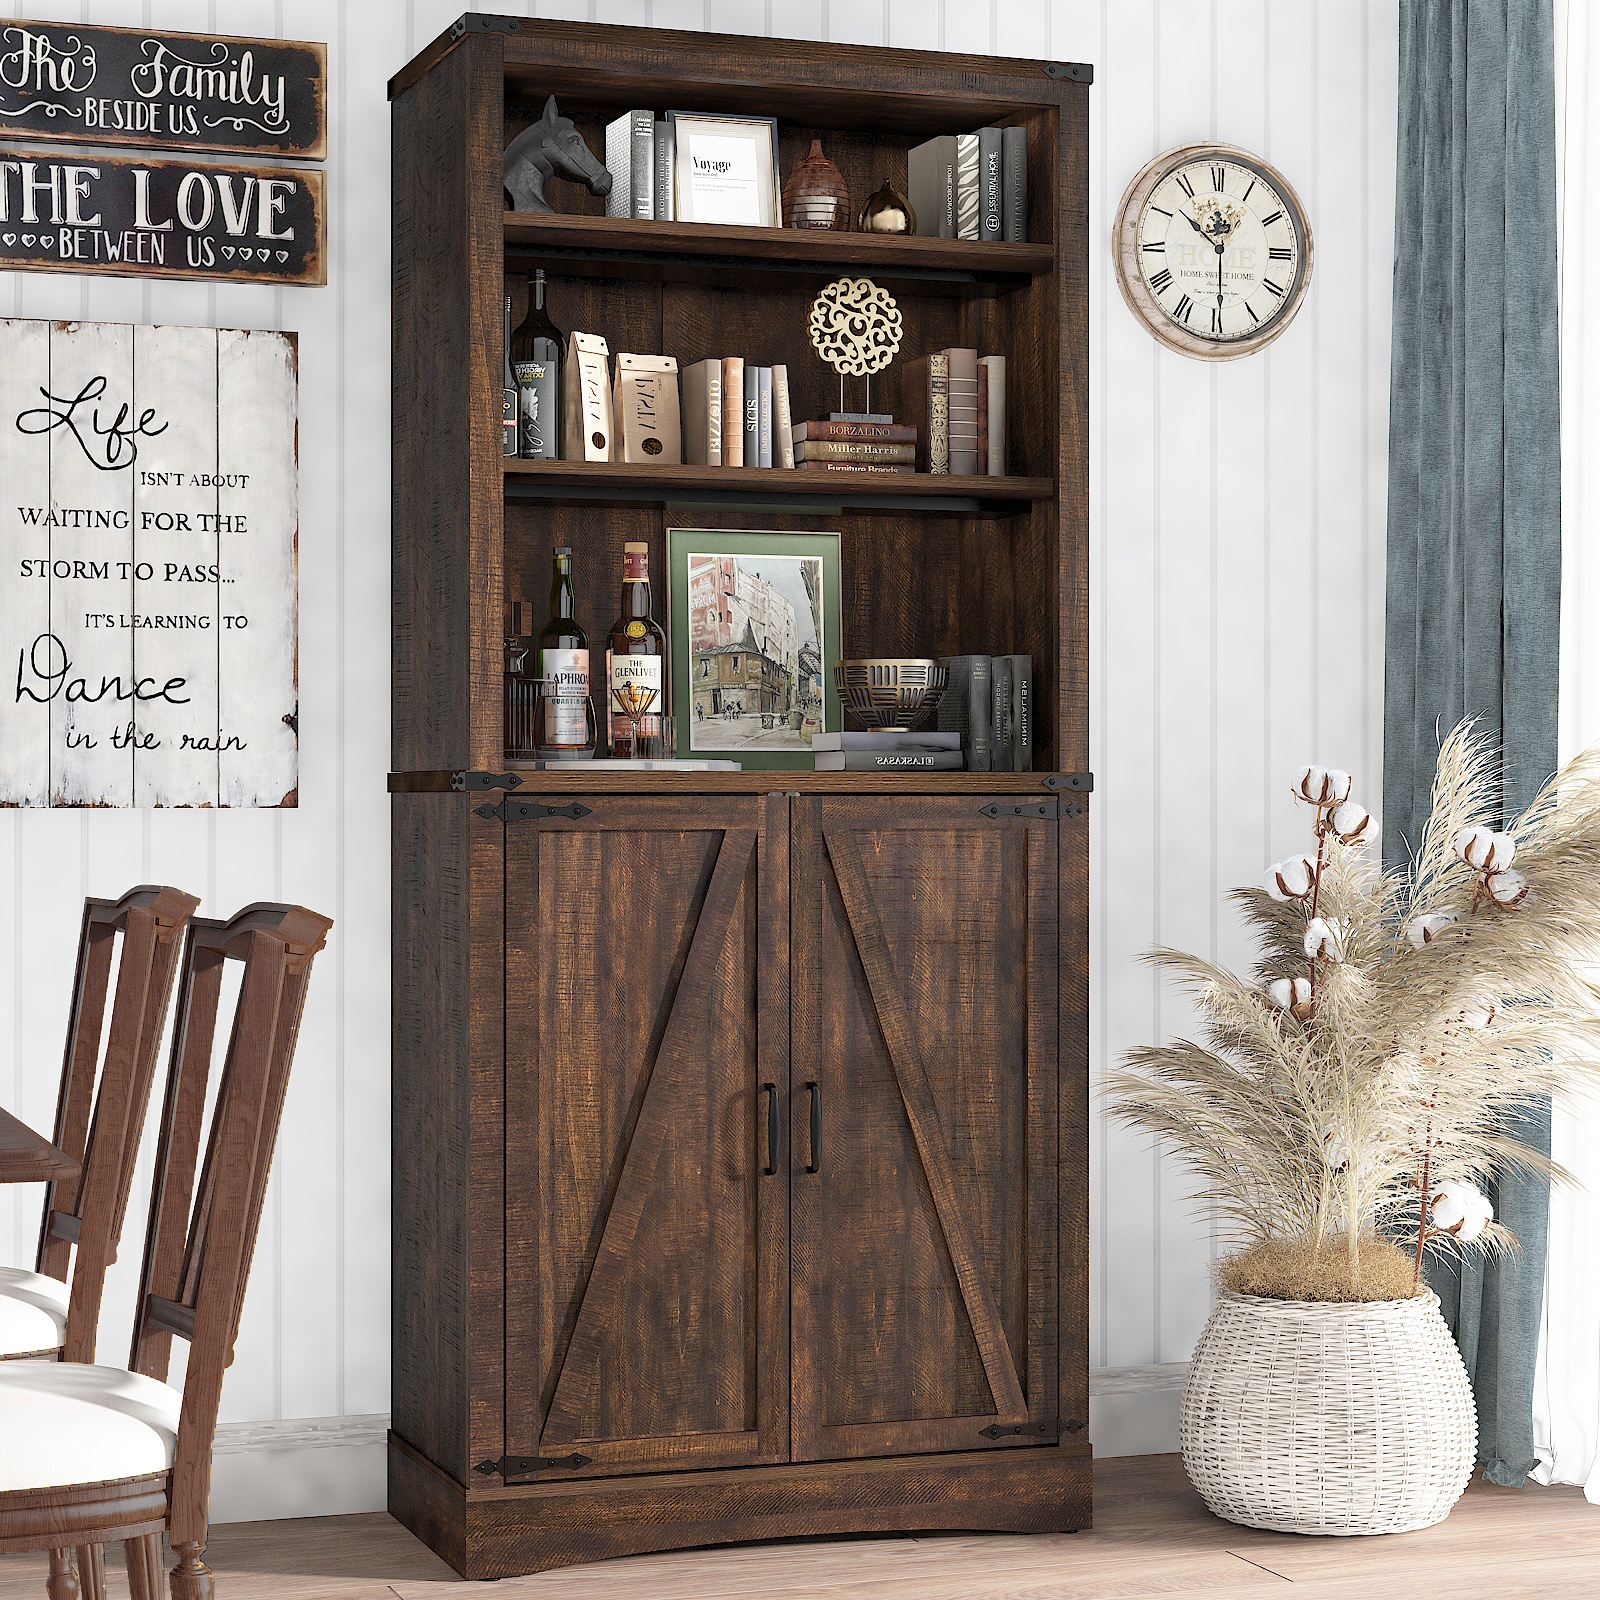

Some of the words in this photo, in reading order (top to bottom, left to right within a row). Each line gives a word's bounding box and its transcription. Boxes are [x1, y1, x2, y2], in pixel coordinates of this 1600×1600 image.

[0, 27, 96, 92] The
[130, 39, 286, 125] Family
[85, 97, 162, 133] BESIDE
[169, 104, 200, 136] US,
[692, 156, 731, 172] Voyage
[988, 152, 997, 175] HOME
[1014, 141, 1023, 193] YEOWARD
[0, 161, 101, 226] THE
[131, 169, 297, 241] LOVE
[988, 176, 996, 212] ESSENTIAL
[1014, 196, 1023, 241] WILLIAM
[59, 228, 165, 265] BETWEEN
[187, 235, 216, 267] US
[1180, 270, 1204, 278] HOME
[1231, 272, 1254, 280] HOME
[747, 400, 758, 432] SICIS
[778, 380, 788, 430] TRUSSARDI
[16, 376, 169, 470] Life
[830, 426, 890, 436] BORZALINO
[828, 444, 861, 454] Miller
[864, 445, 898, 454] Harris
[140, 471, 185, 488] ISN'T
[190, 473, 250, 490] ABOUT
[827, 464, 866, 472] Furniture
[18, 507, 130, 530] WAITING
[141, 511, 193, 532] FOR
[196, 513, 248, 534] THE
[20, 559, 110, 580] STORM
[116, 562, 154, 582] TO
[164, 563, 236, 584] PASS...
[85, 613, 116, 629] IT'S
[120, 614, 212, 630] LEARNING
[224, 615, 249, 630] TO
[16, 634, 191, 704] Dance
[614, 668, 657, 678] GLENLIVET
[66, 724, 98, 750] in
[110, 720, 160, 750] the
[180, 728, 248, 752] rain
